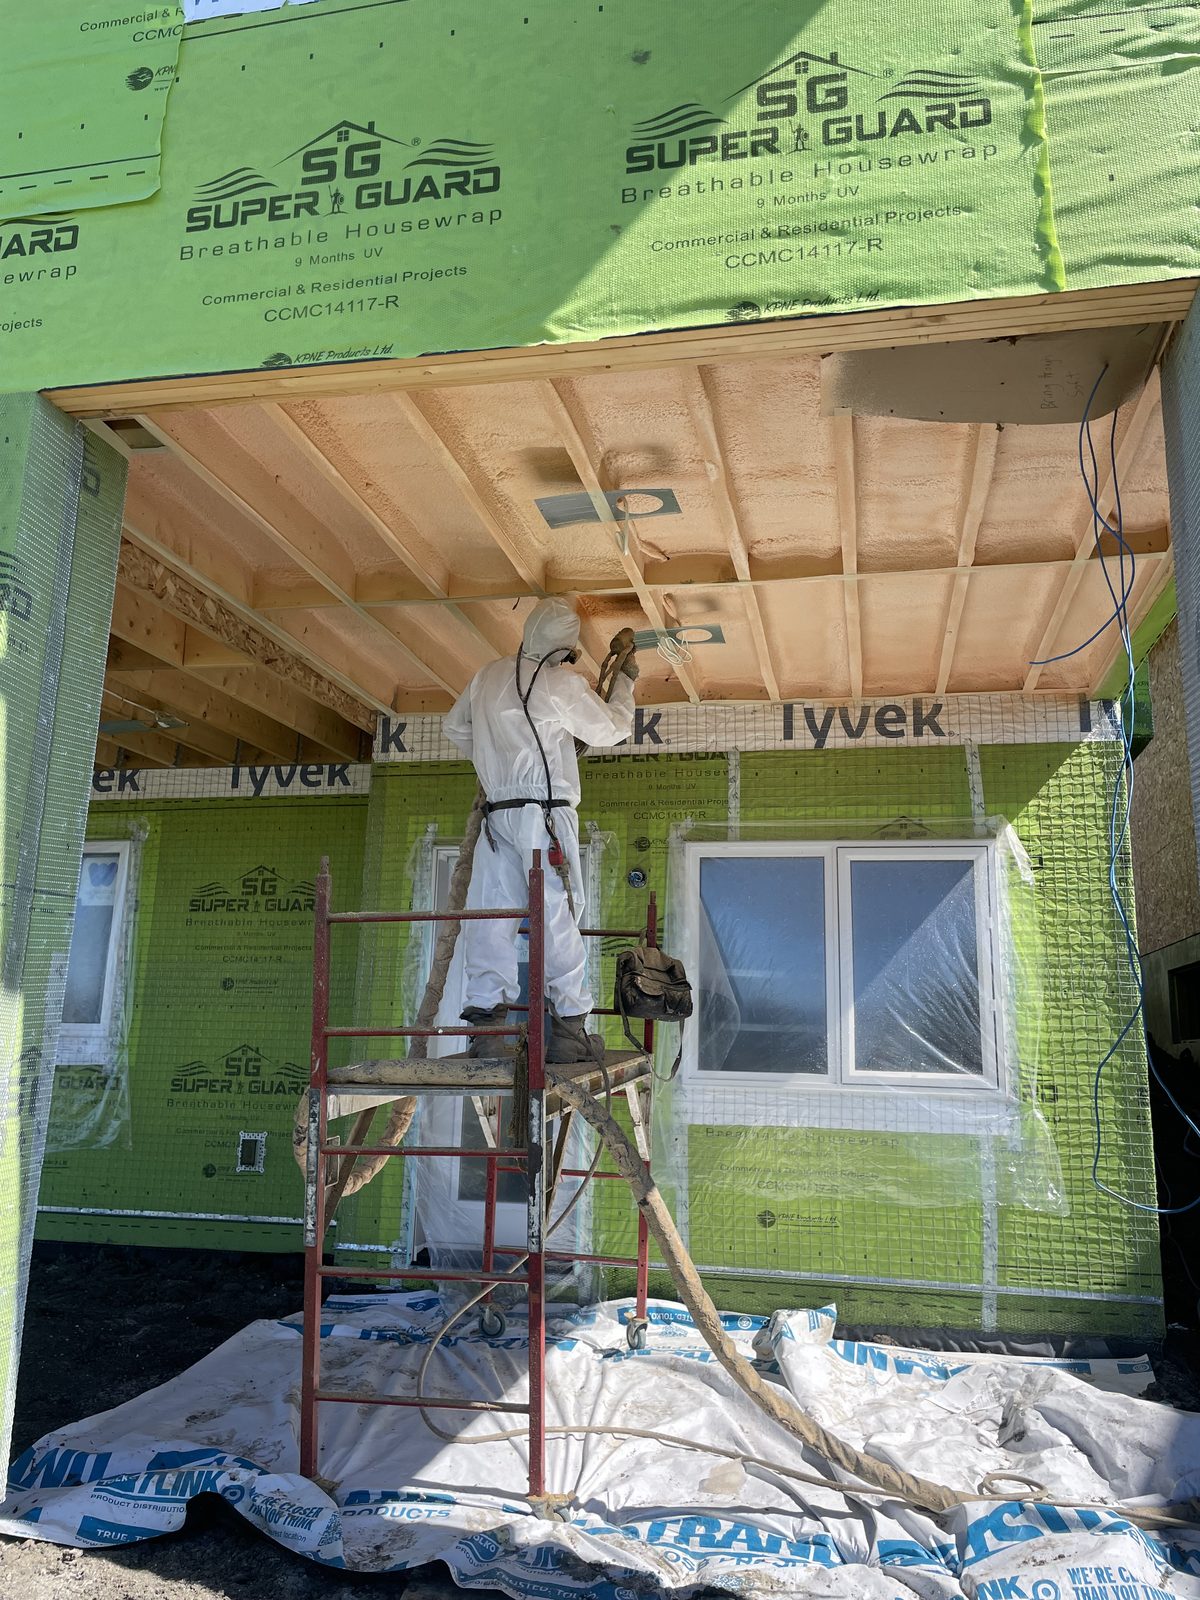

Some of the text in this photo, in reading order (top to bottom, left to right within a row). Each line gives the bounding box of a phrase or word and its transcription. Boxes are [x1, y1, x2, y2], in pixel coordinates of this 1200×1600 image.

[80, 9, 158, 32] Commercial
[162, 8, 171, 18] &
[756, 72, 849, 122] SG
[625, 98, 992, 174] SUPER GUARD
[301, 141, 381, 186] SG
[622, 144, 998, 203] Breathable Housewrap
[185, 166, 501, 232] SUPER GUARD
[757, 185, 860, 208] 9 Months UV
[0, 224, 79, 259] ARD
[180, 208, 503, 260] Breathable Housewrap
[651, 204, 962, 252] Commercial & Residential Projects
[295, 247, 383, 267] 9 Months UV
[724, 237, 884, 269] CCMC14117-R
[202, 265, 468, 306] Commercial & Residential Projects
[264, 295, 400, 322] CCMC14117-R
[294, 343, 393, 363] KPNE Products Ltd.
[241, 878, 278, 896] SG
[188, 899, 249, 912] SUPER
[224, 1057, 262, 1077] SG
[170, 1078, 232, 1093] SUPER
[90, 1494, 186, 1513] PRODUCT DISTRIBUTIO
[1067, 1566, 1117, 1585] WE'RE
